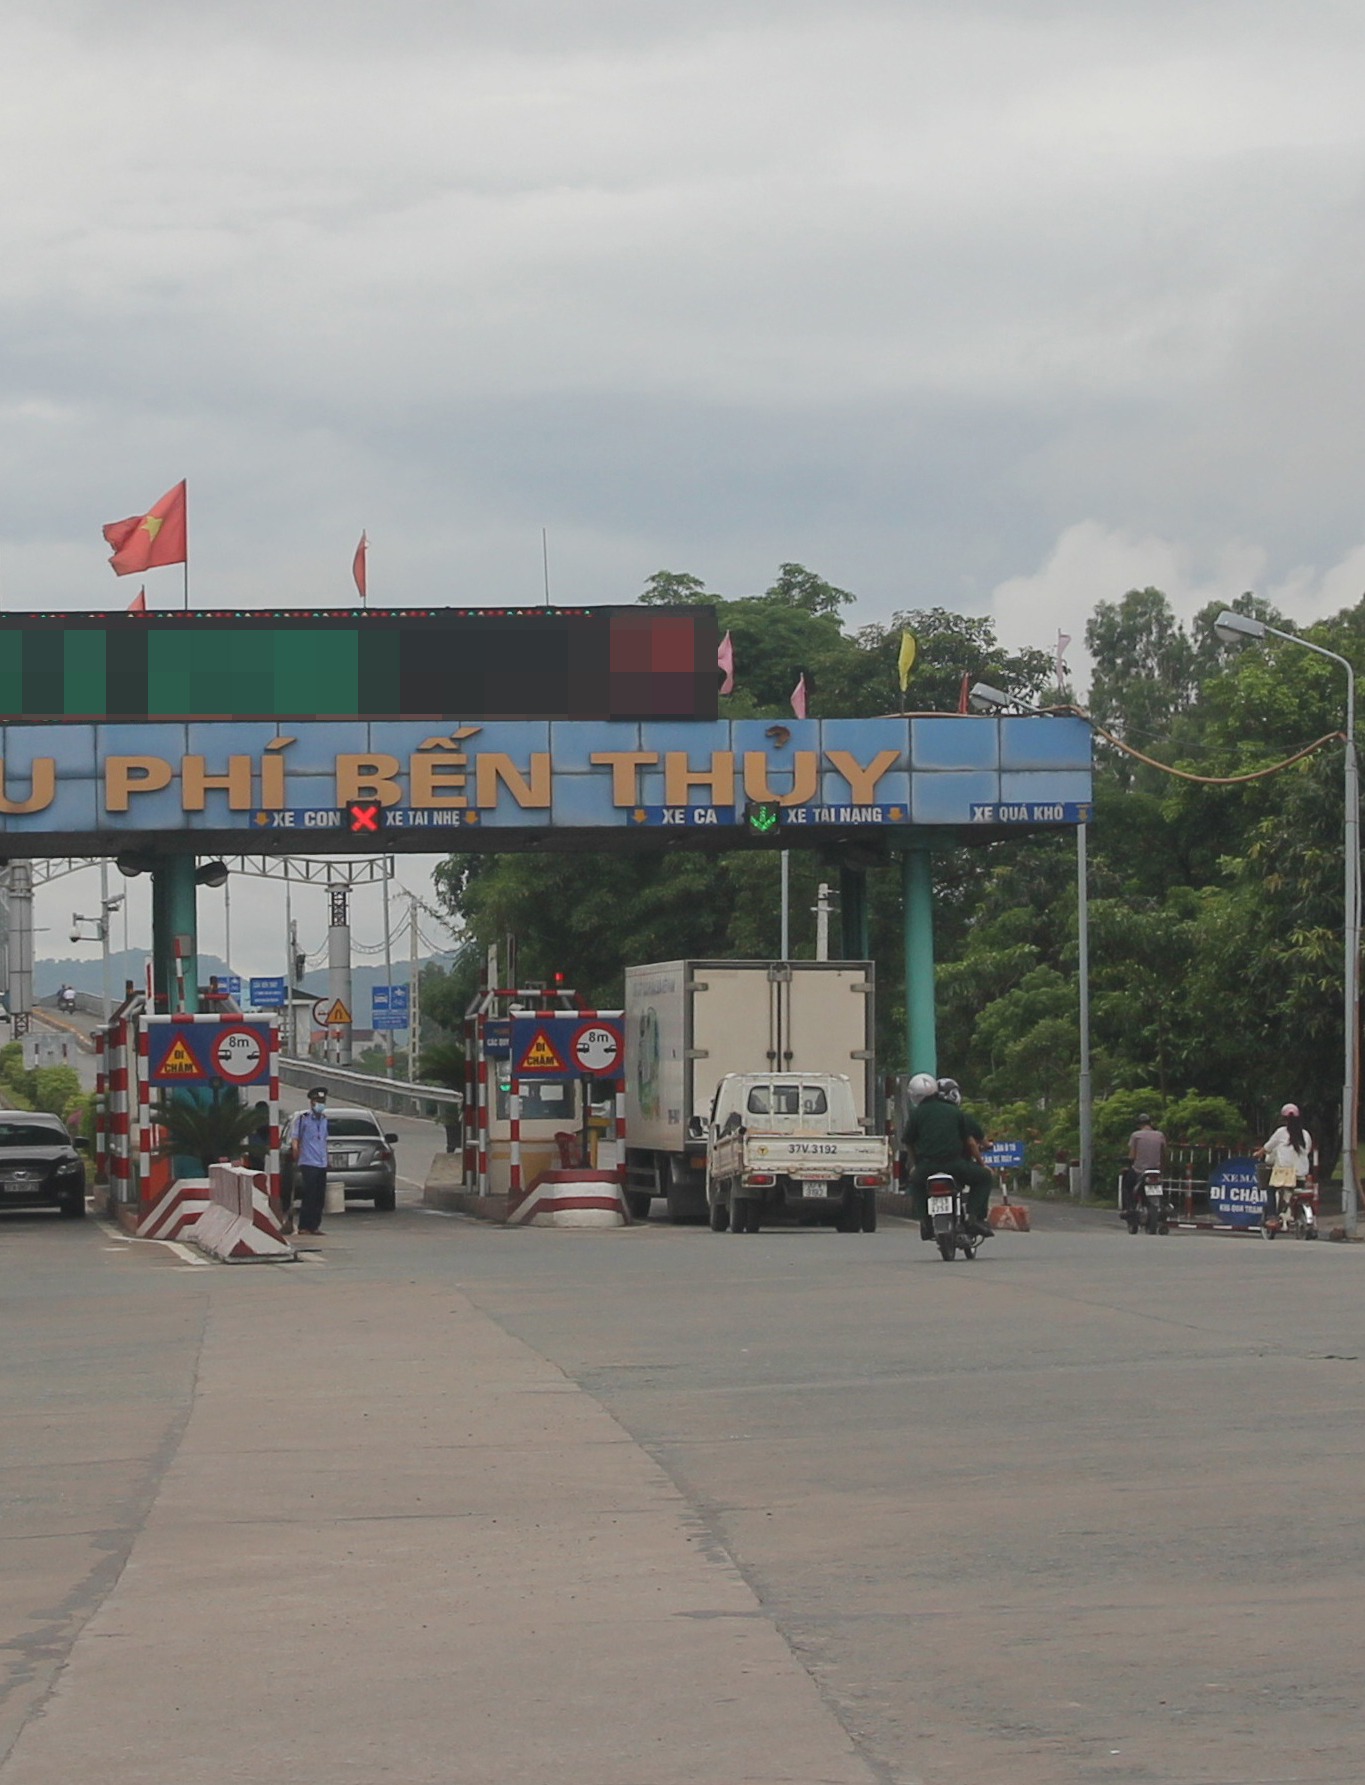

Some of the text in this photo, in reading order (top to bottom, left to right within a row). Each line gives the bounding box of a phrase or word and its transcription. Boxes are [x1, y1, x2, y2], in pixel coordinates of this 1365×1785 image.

[105, 737, 297, 812] PHÍ
[335, 727, 551, 808] BẾN
[590, 725, 901, 807] THỦY
[272, 811, 296, 827] XE
[304, 811, 341, 827] CON
[386, 811, 404, 826] XE
[662, 808, 685, 824] XE
[787, 808, 807, 823] XE
[973, 806, 993, 821] XE
[229, 1036, 249, 1048] 8m
[589, 1032, 609, 1043] 8m
[788, 1144, 837, 1154] 37V.3192
